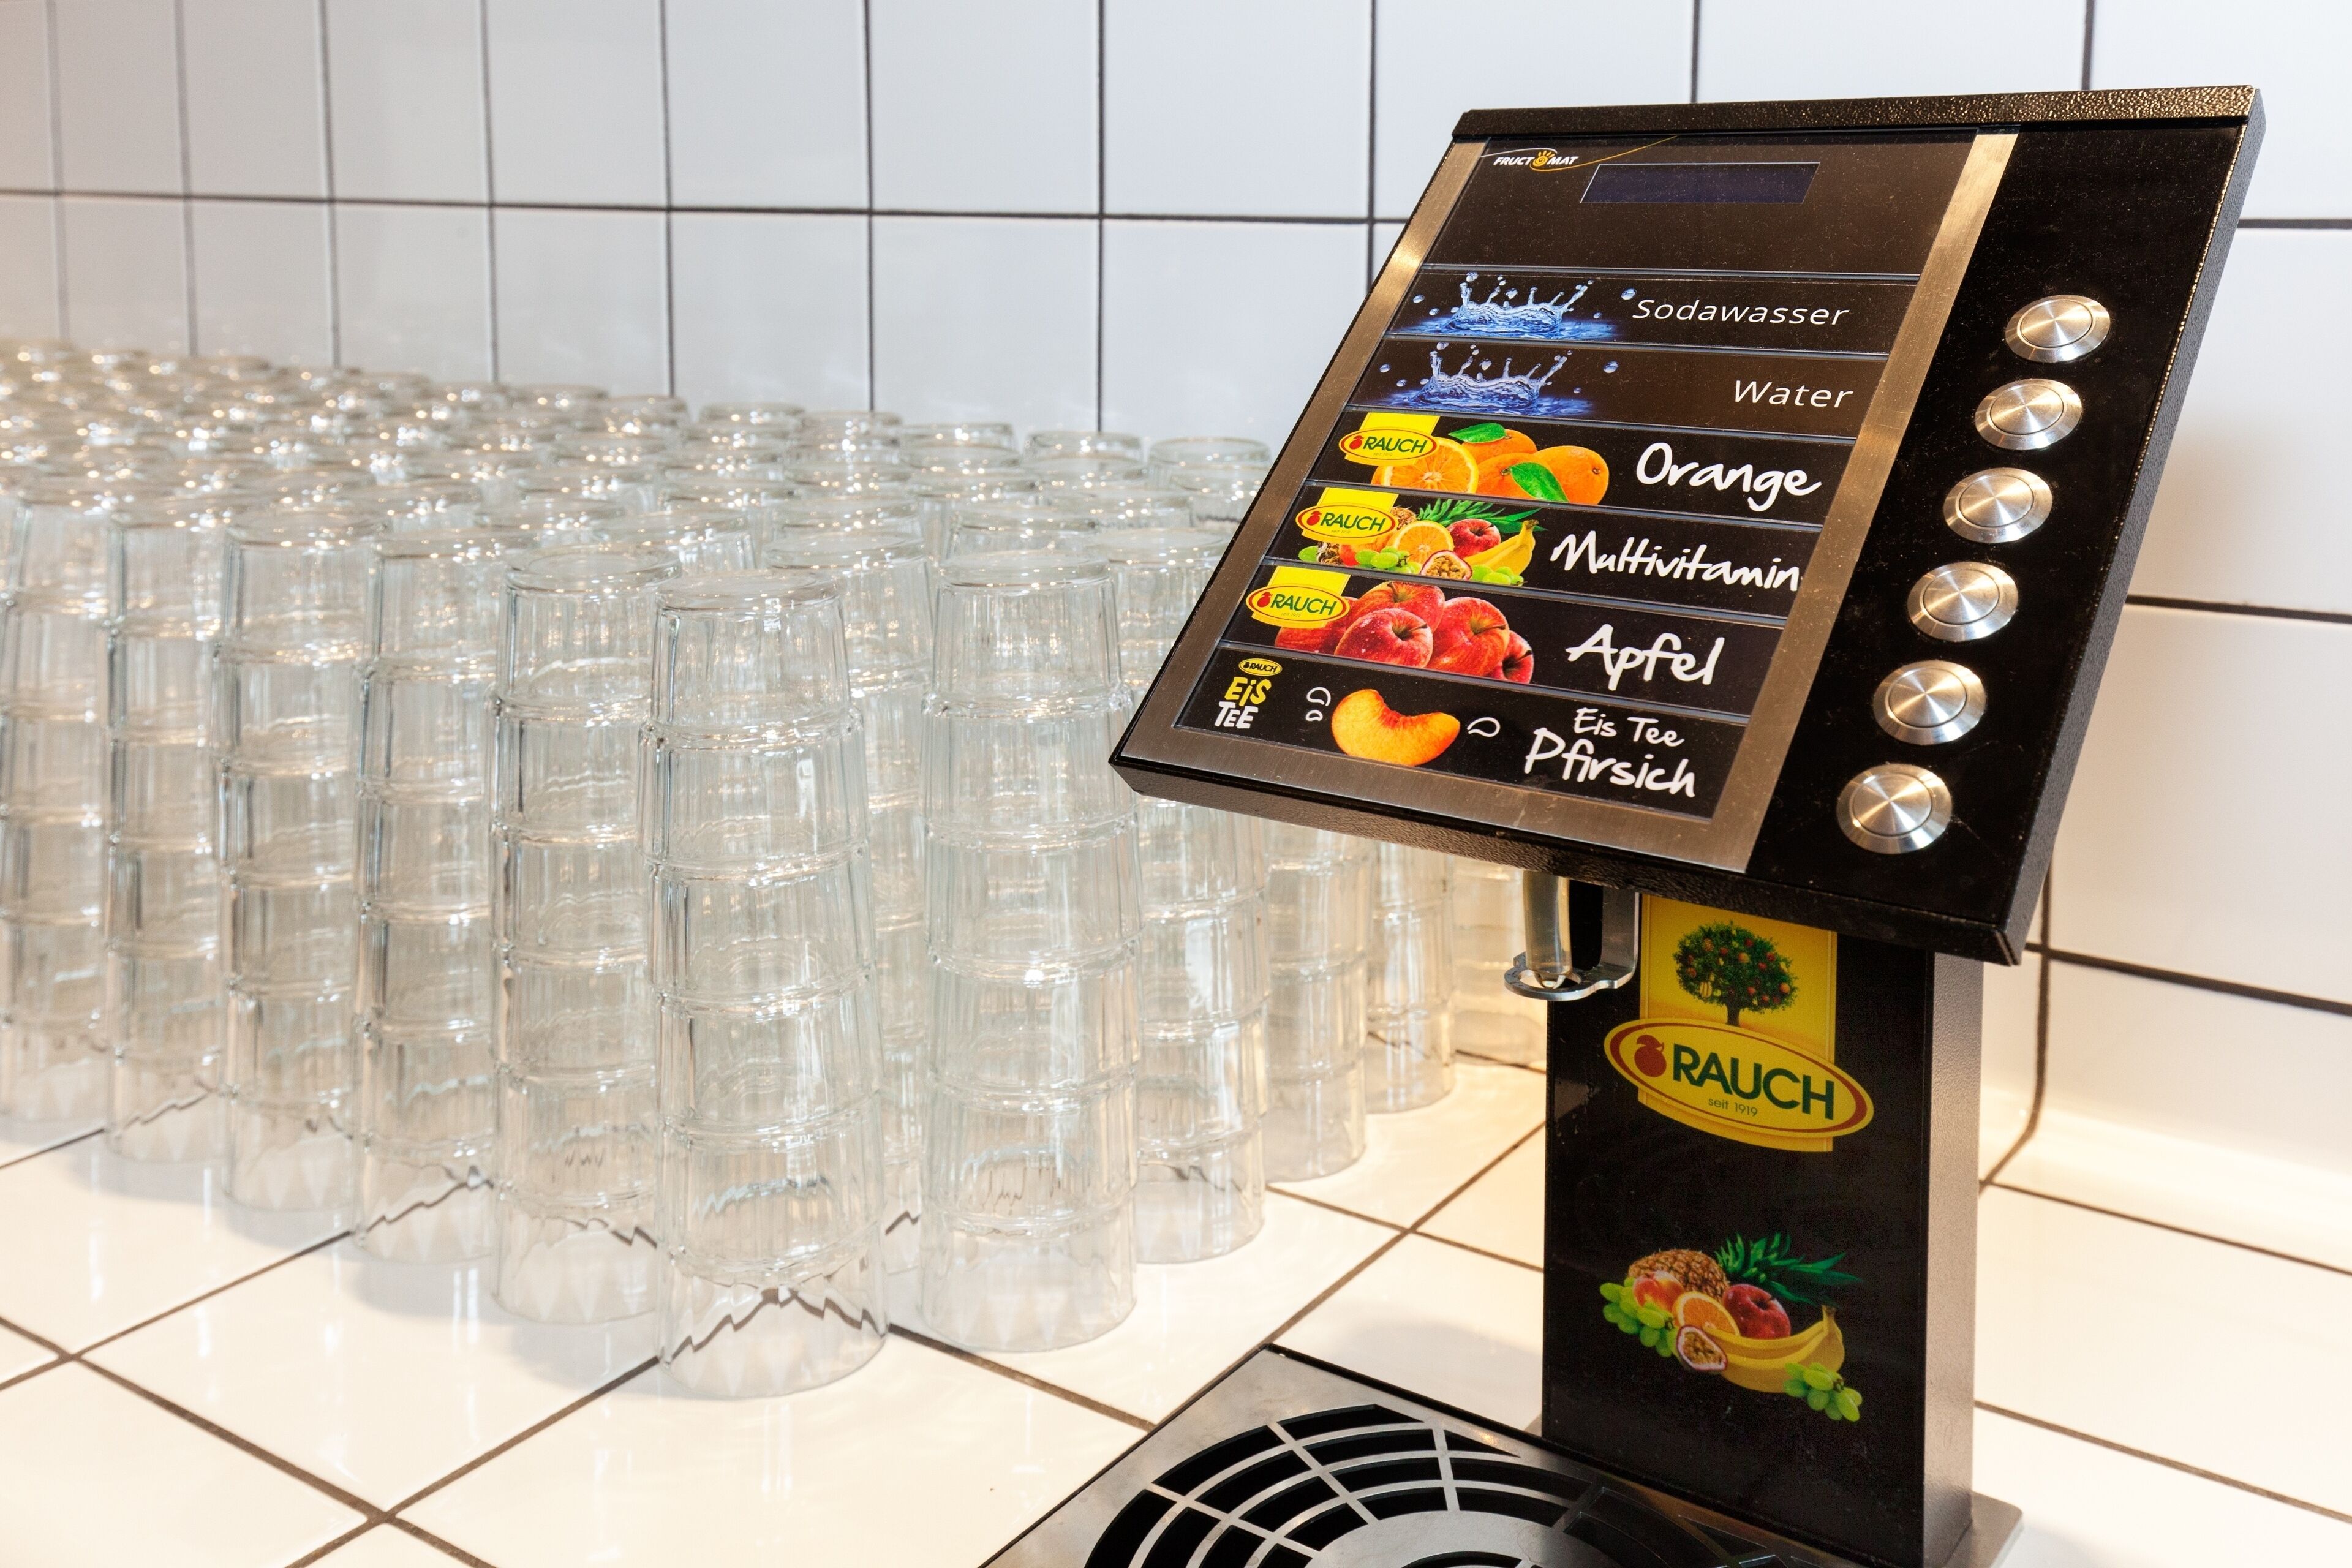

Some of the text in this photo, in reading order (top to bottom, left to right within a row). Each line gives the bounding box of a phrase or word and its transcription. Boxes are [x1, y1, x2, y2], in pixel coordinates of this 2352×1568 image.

[1632, 299, 1849, 325] Sodawasser
[1735, 380, 1853, 408] Water
[1363, 436, 1428, 453] RAUCH
[1636, 442, 1822, 511] Orange
[1321, 512, 1386, 532] RAUCH
[1550, 530, 1799, 592] Multivitamin
[1270, 594, 1337, 615] RAUCH
[1250, 663, 1277, 673] RAUCH
[1566, 624, 1723, 691] Apfel
[1574, 707, 1684, 747] Eis Tee
[1524, 727, 1695, 797] Pfirsich
[1673, 1043, 1835, 1120] RAUCH
[1708, 1098, 1758, 1117] seit 1919
